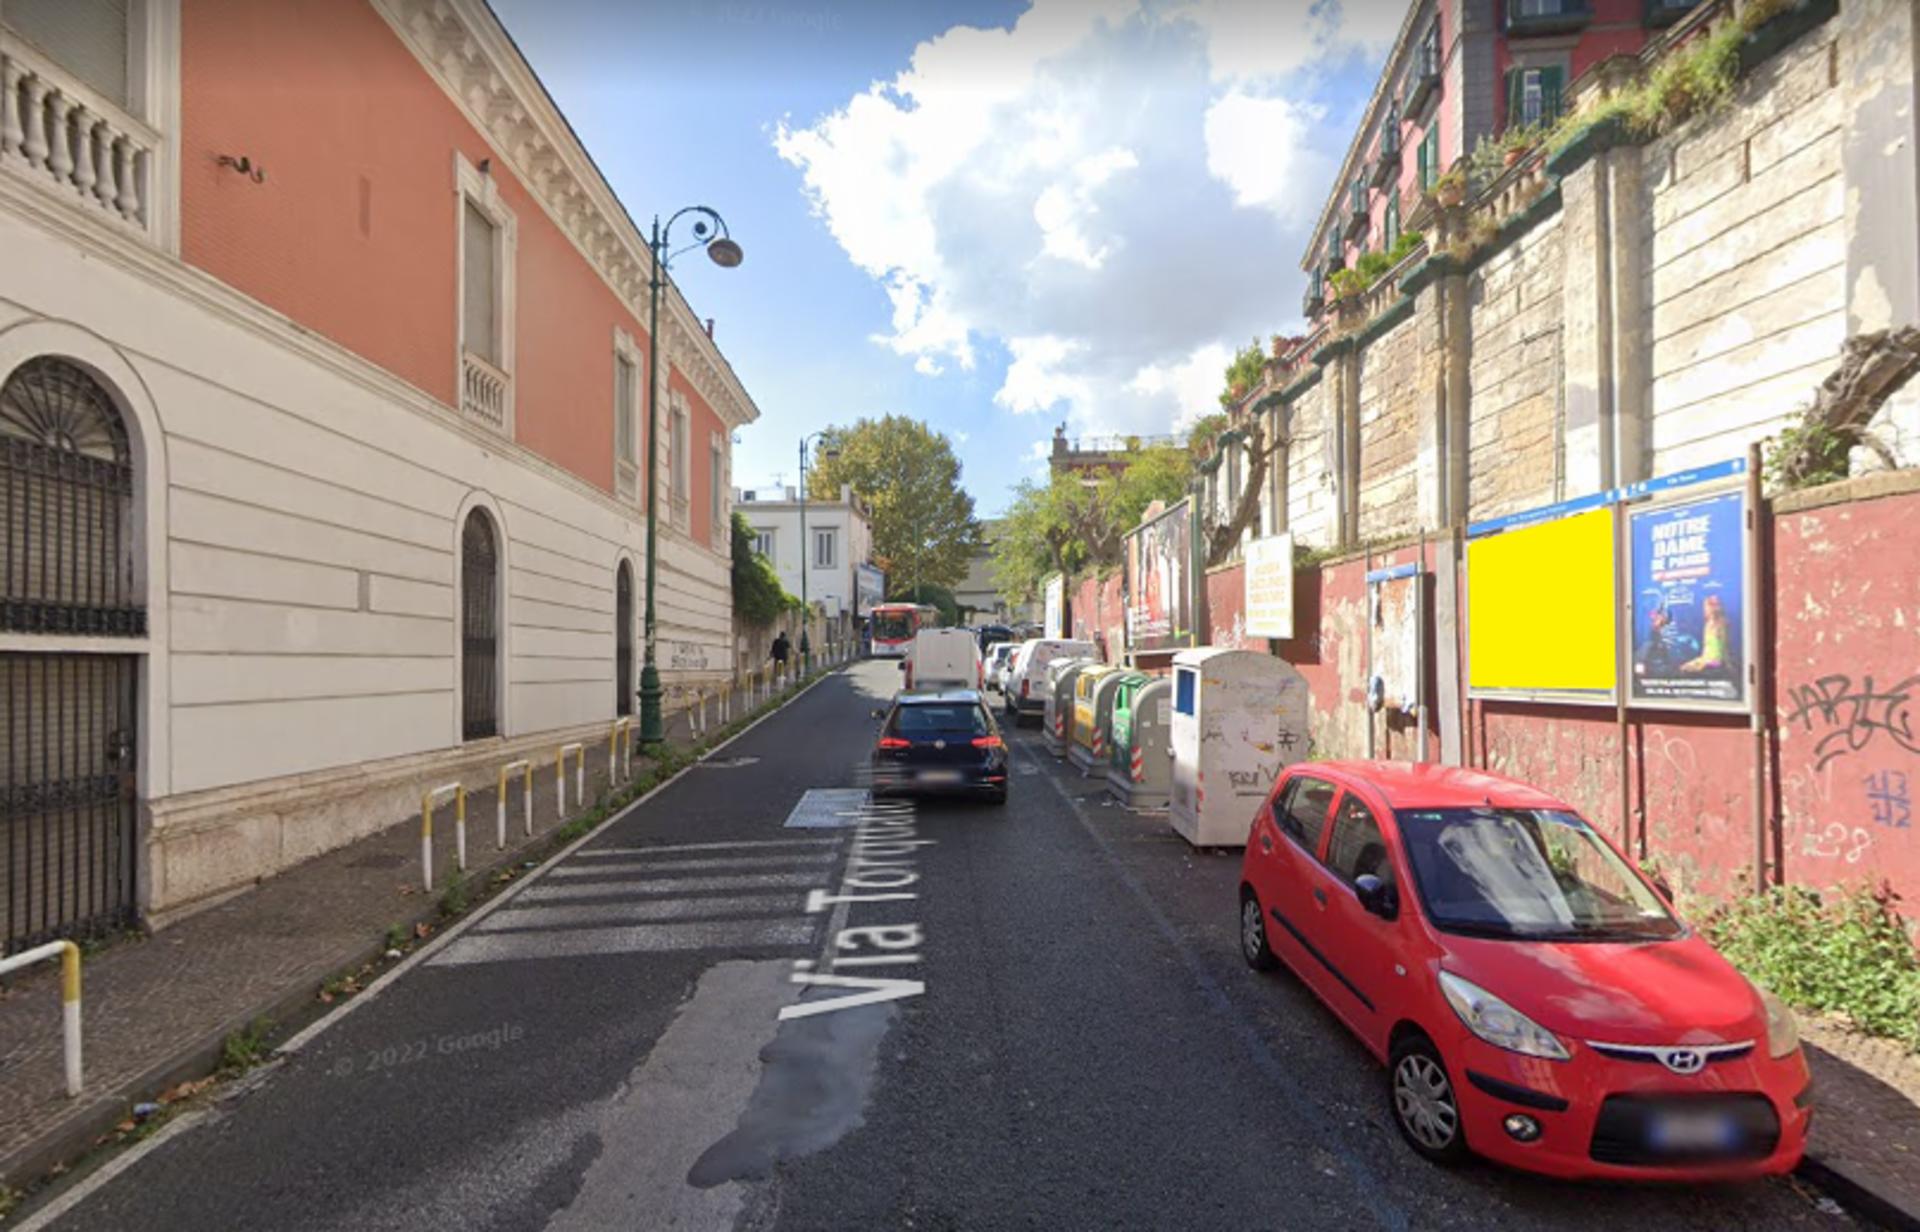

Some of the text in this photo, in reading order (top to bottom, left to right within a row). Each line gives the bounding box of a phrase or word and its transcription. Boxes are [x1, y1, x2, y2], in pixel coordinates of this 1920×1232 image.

[1652, 515, 1711, 541] NOTRE
[1653, 535, 1708, 558] DAME
[1668, 553, 1710, 569] PARIS
